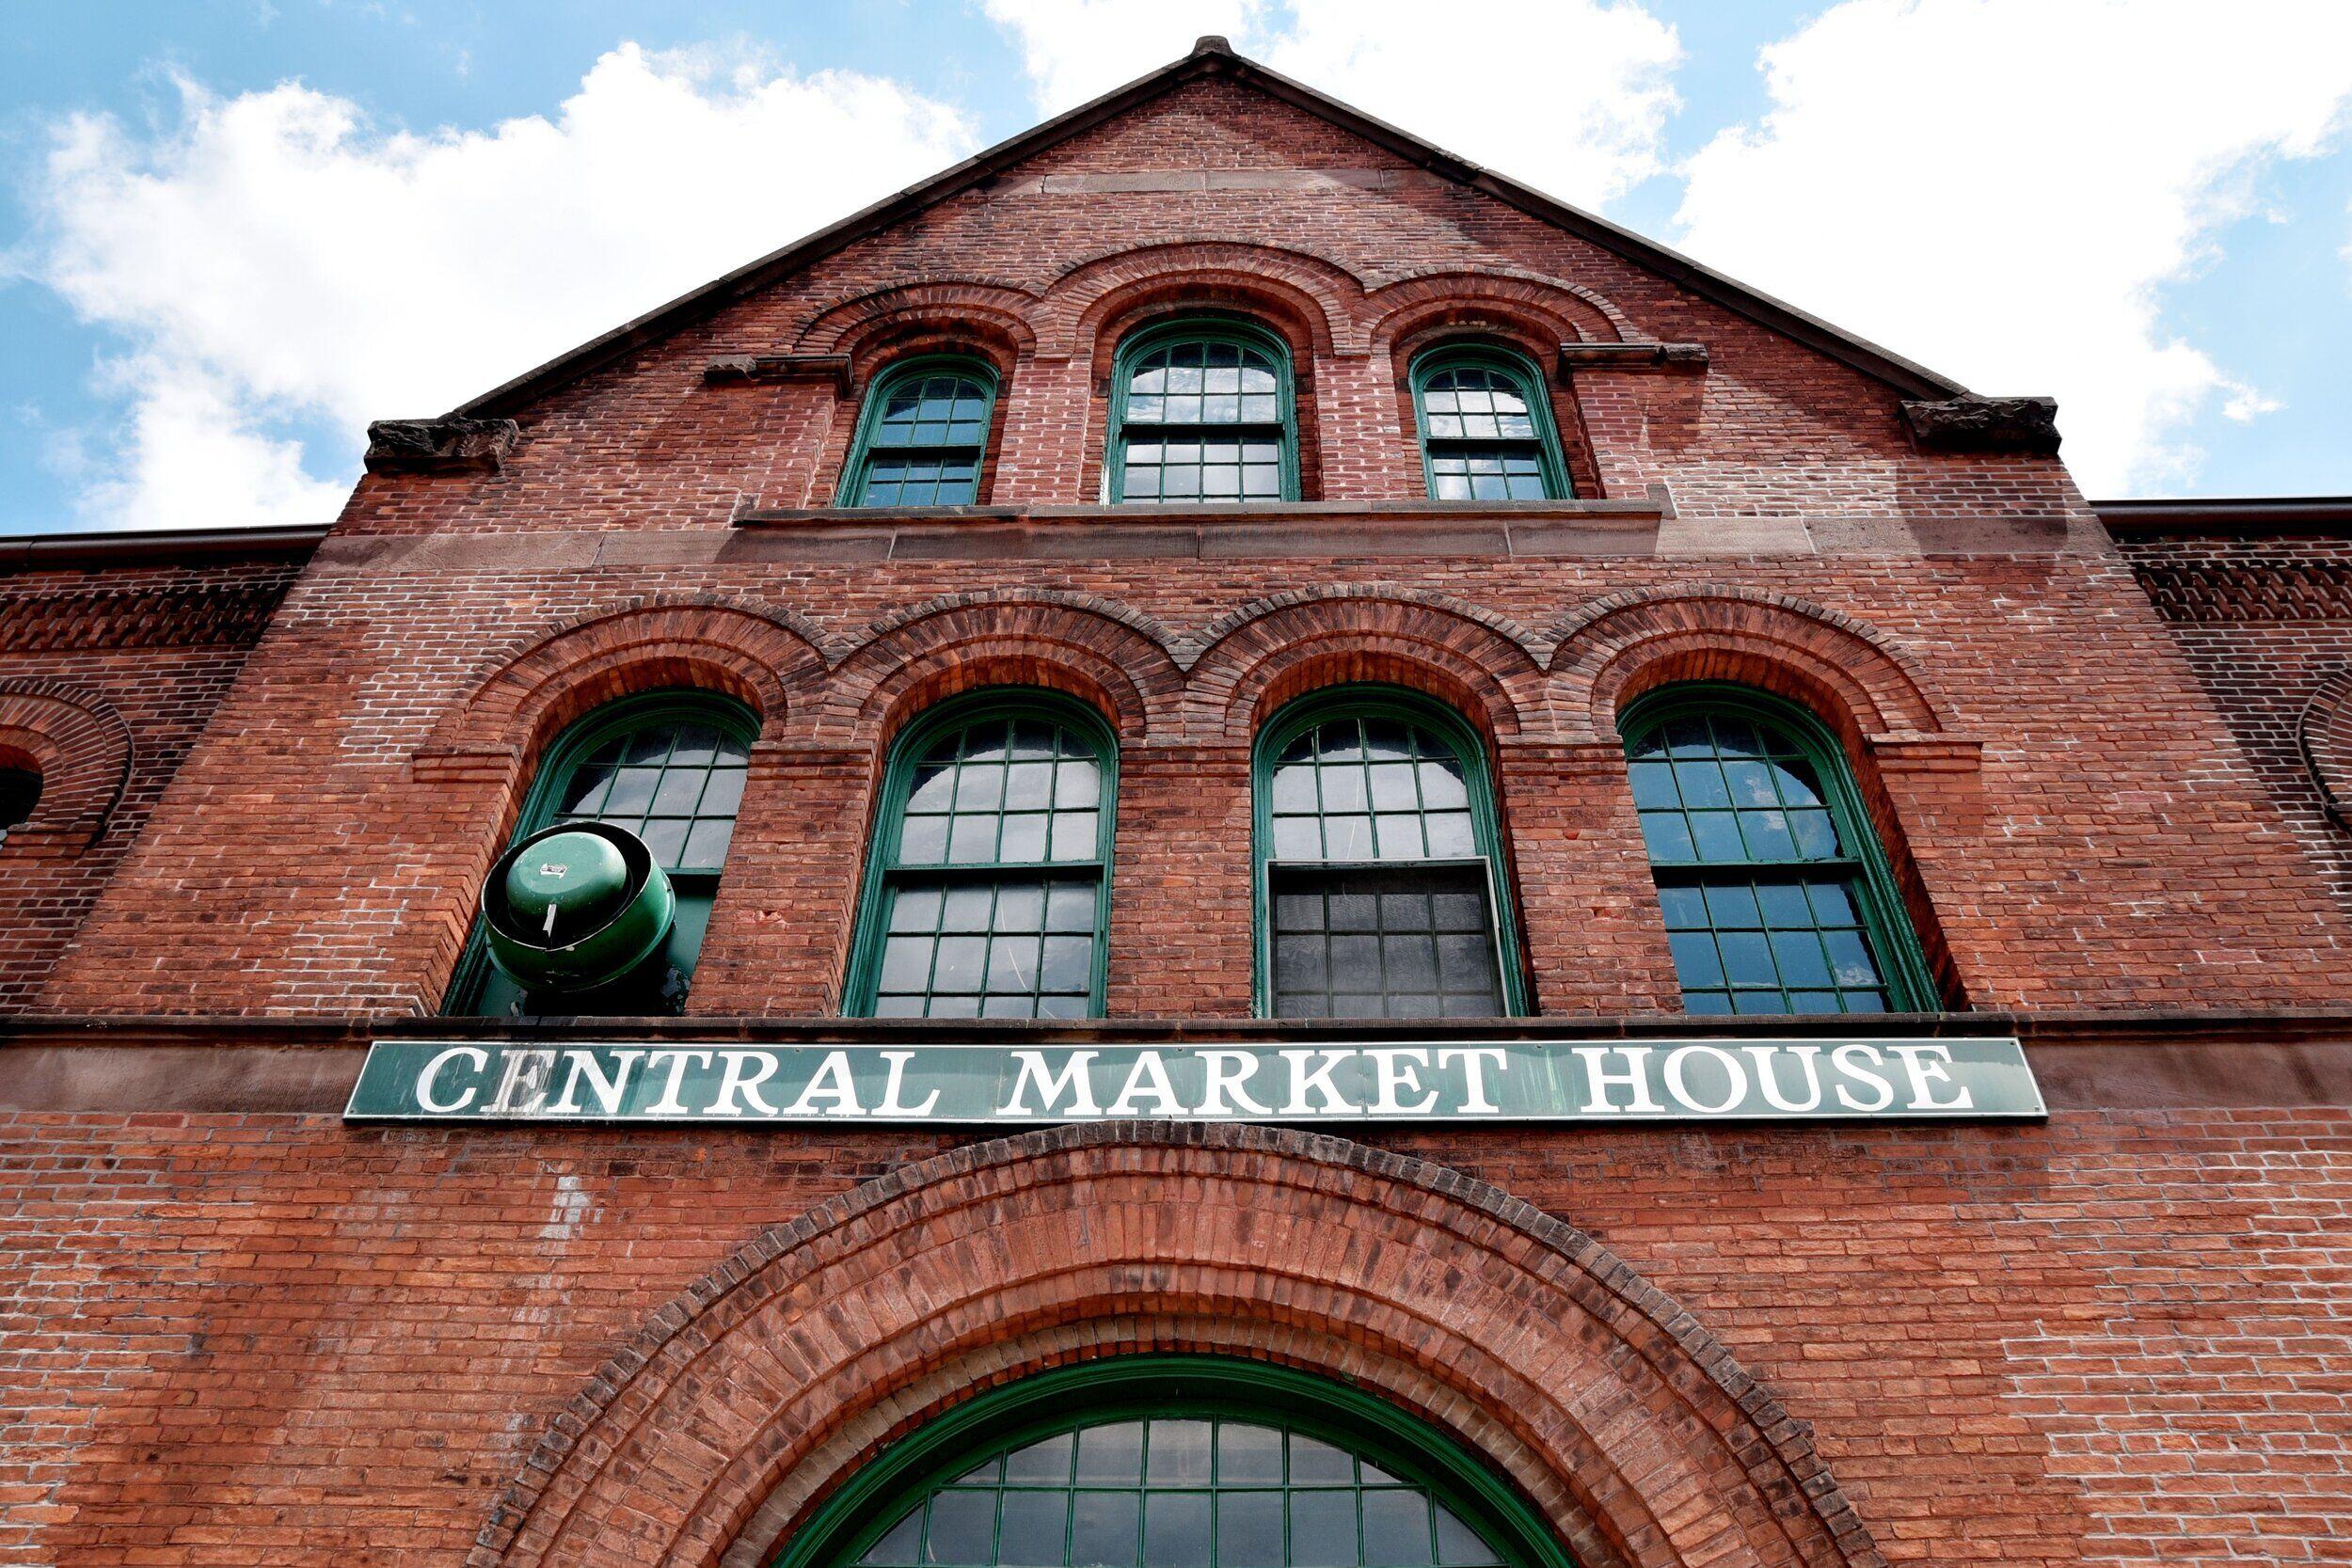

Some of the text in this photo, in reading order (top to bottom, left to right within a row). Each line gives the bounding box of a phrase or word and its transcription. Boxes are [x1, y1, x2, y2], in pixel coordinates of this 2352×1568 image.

[416, 1044, 1974, 1117] CENTRAL MARKET HOUSE
